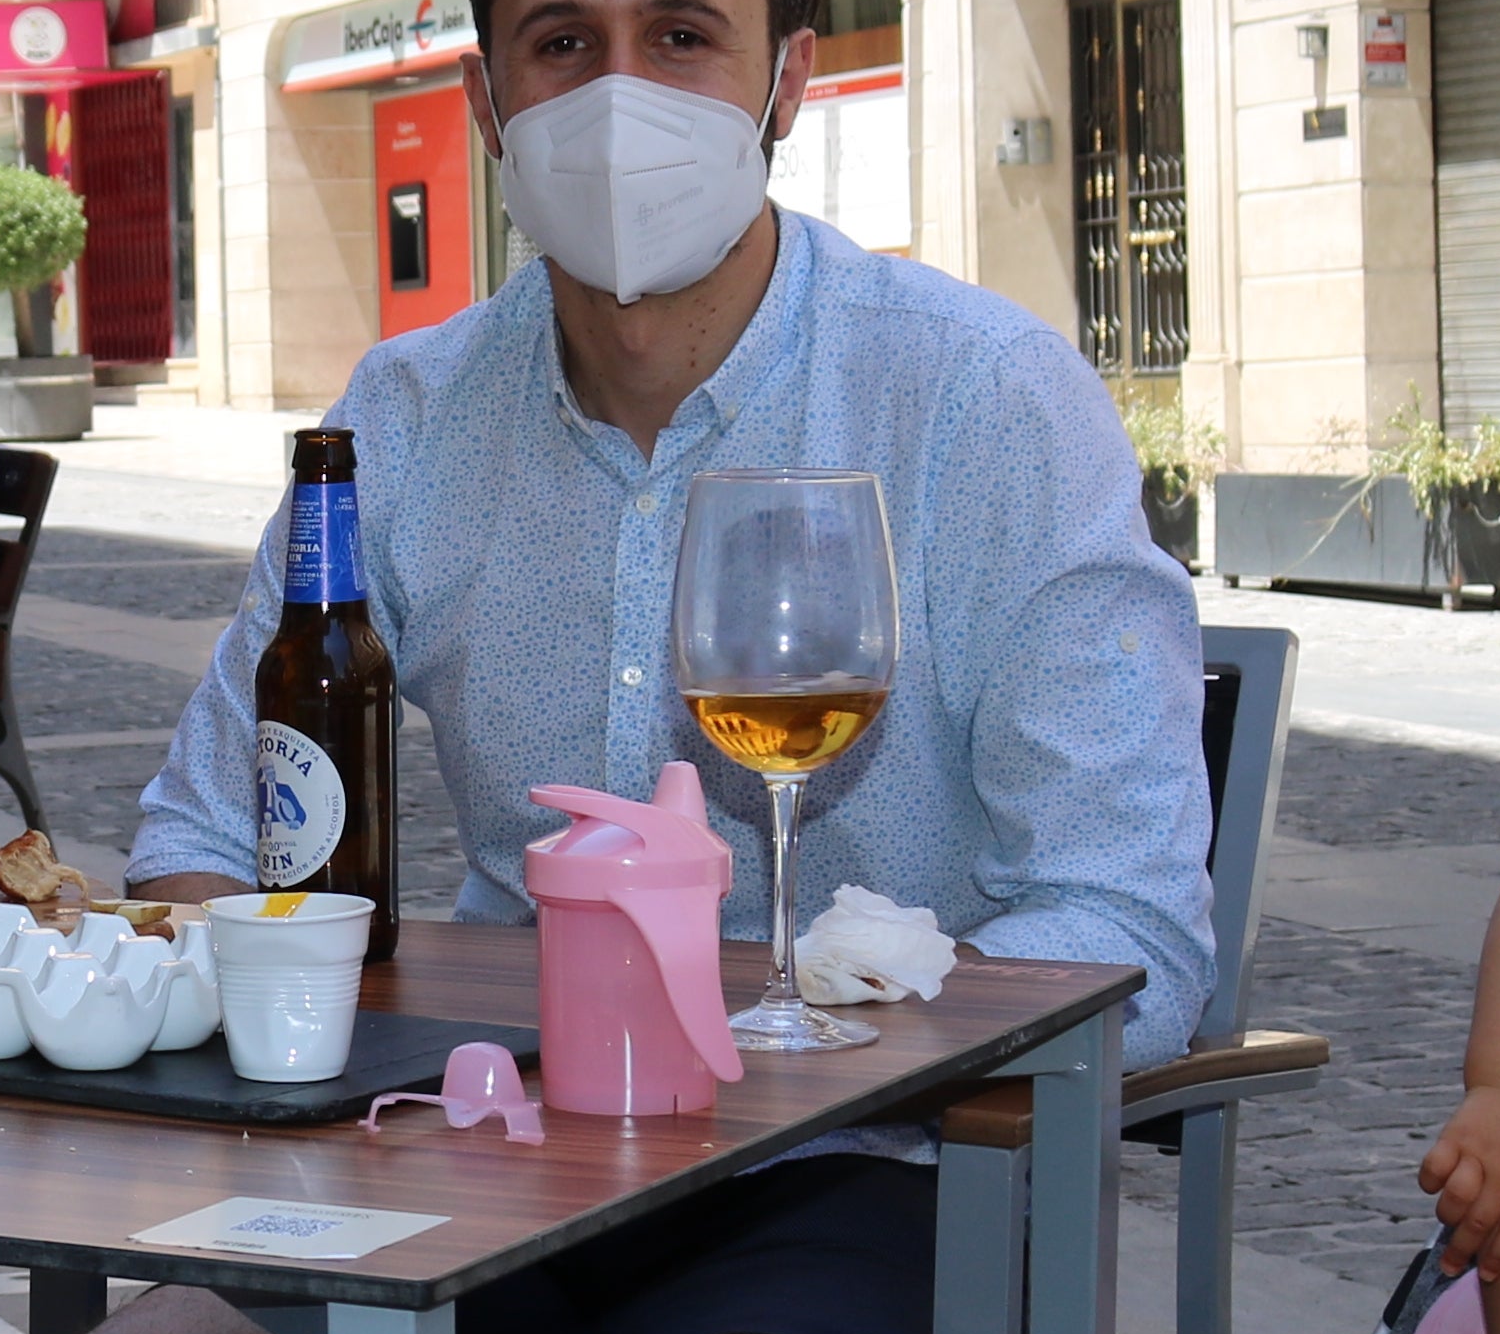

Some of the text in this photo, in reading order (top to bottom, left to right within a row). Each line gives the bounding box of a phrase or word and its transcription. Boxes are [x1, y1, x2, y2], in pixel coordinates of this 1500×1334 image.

[345, 13, 402, 51] iberCaja
[273, 728, 320, 763] EXQUISITA
[262, 852, 294, 871] SIN
